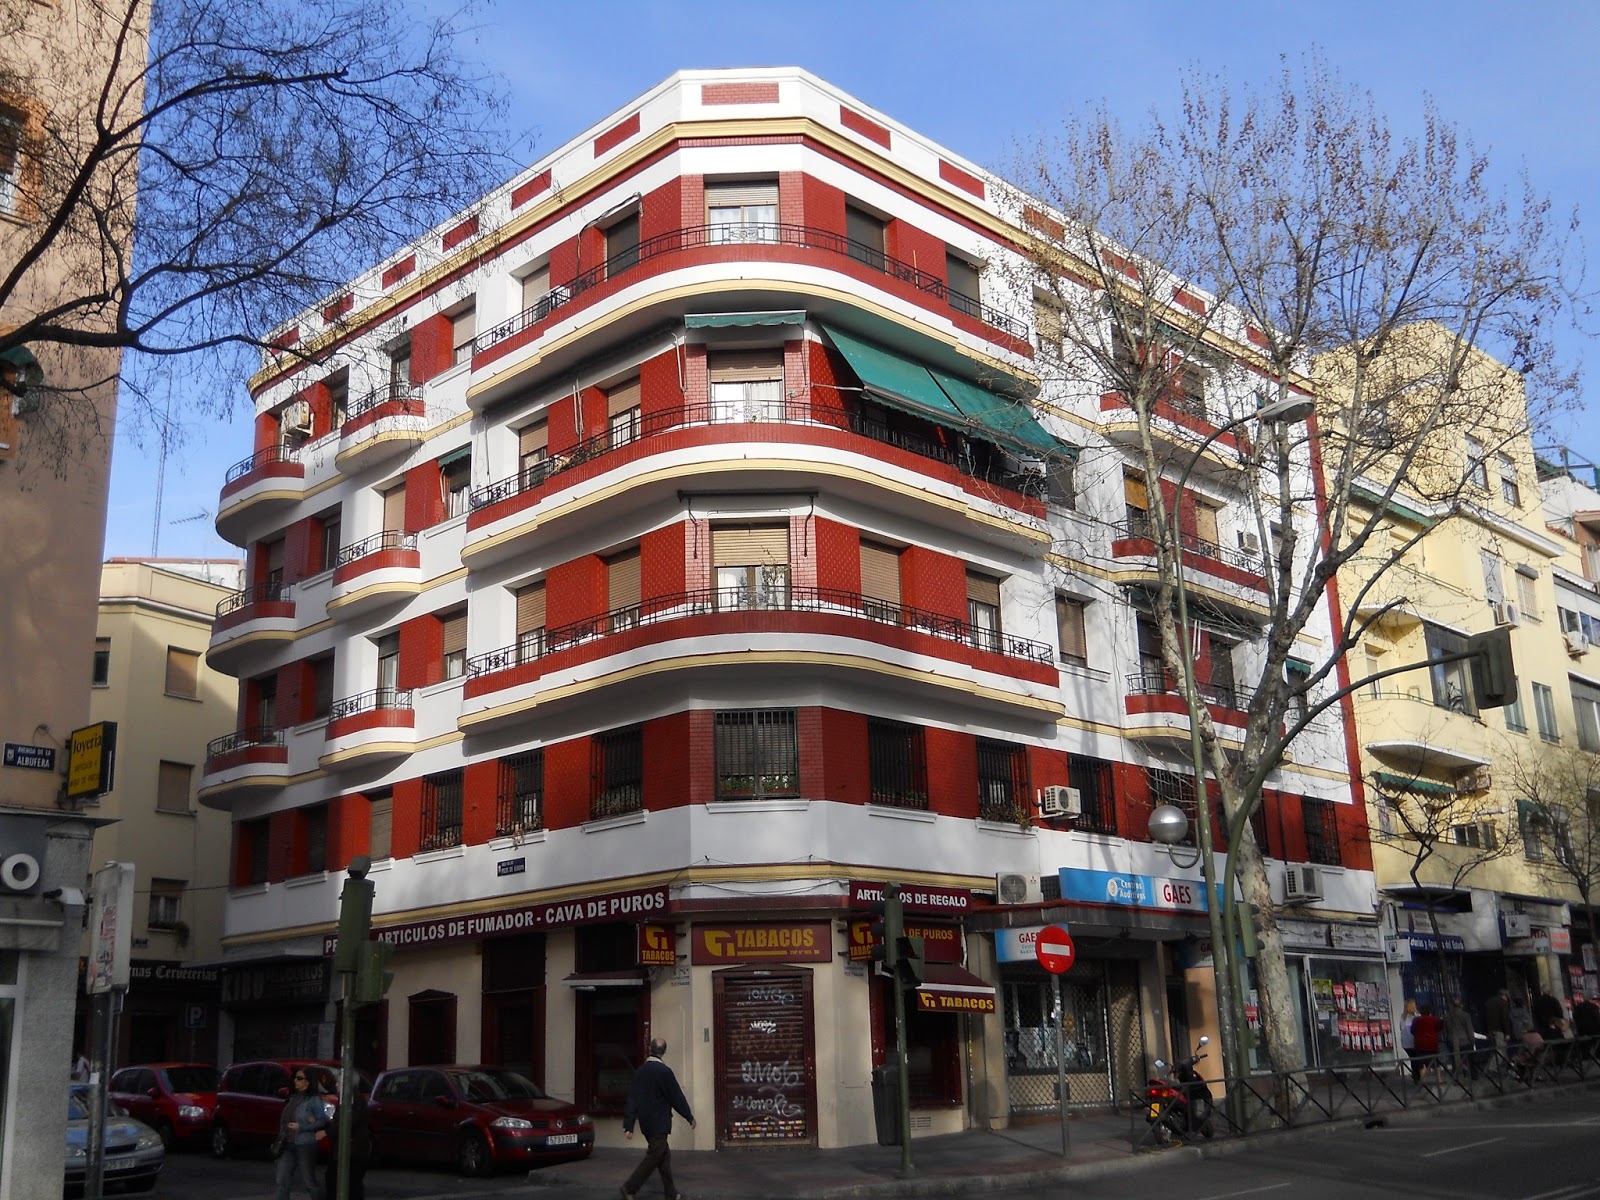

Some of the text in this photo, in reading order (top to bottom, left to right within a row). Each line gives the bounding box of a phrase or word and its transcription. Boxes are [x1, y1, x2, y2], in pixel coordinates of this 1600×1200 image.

[17, 756, 50, 768] ALBUFERA
[915, 893, 928, 905] DE
[930, 894, 967, 908] REGALO
[1163, 883, 1192, 905] GAES
[377, 923, 445, 945] ARTICULOS
[448, 919, 465, 937] DE
[467, 911, 534, 935] FUMADOR
[545, 903, 584, 923] CAVA
[587, 900, 607, 918] DE
[610, 892, 665, 915] PUROS
[735, 928, 814, 948] TABACOS
[923, 928, 953, 940] PUROS
[641, 949, 675, 961] TABACOS
[849, 943, 875, 957] TABAC
[939, 996, 994, 1010] TABACOS
